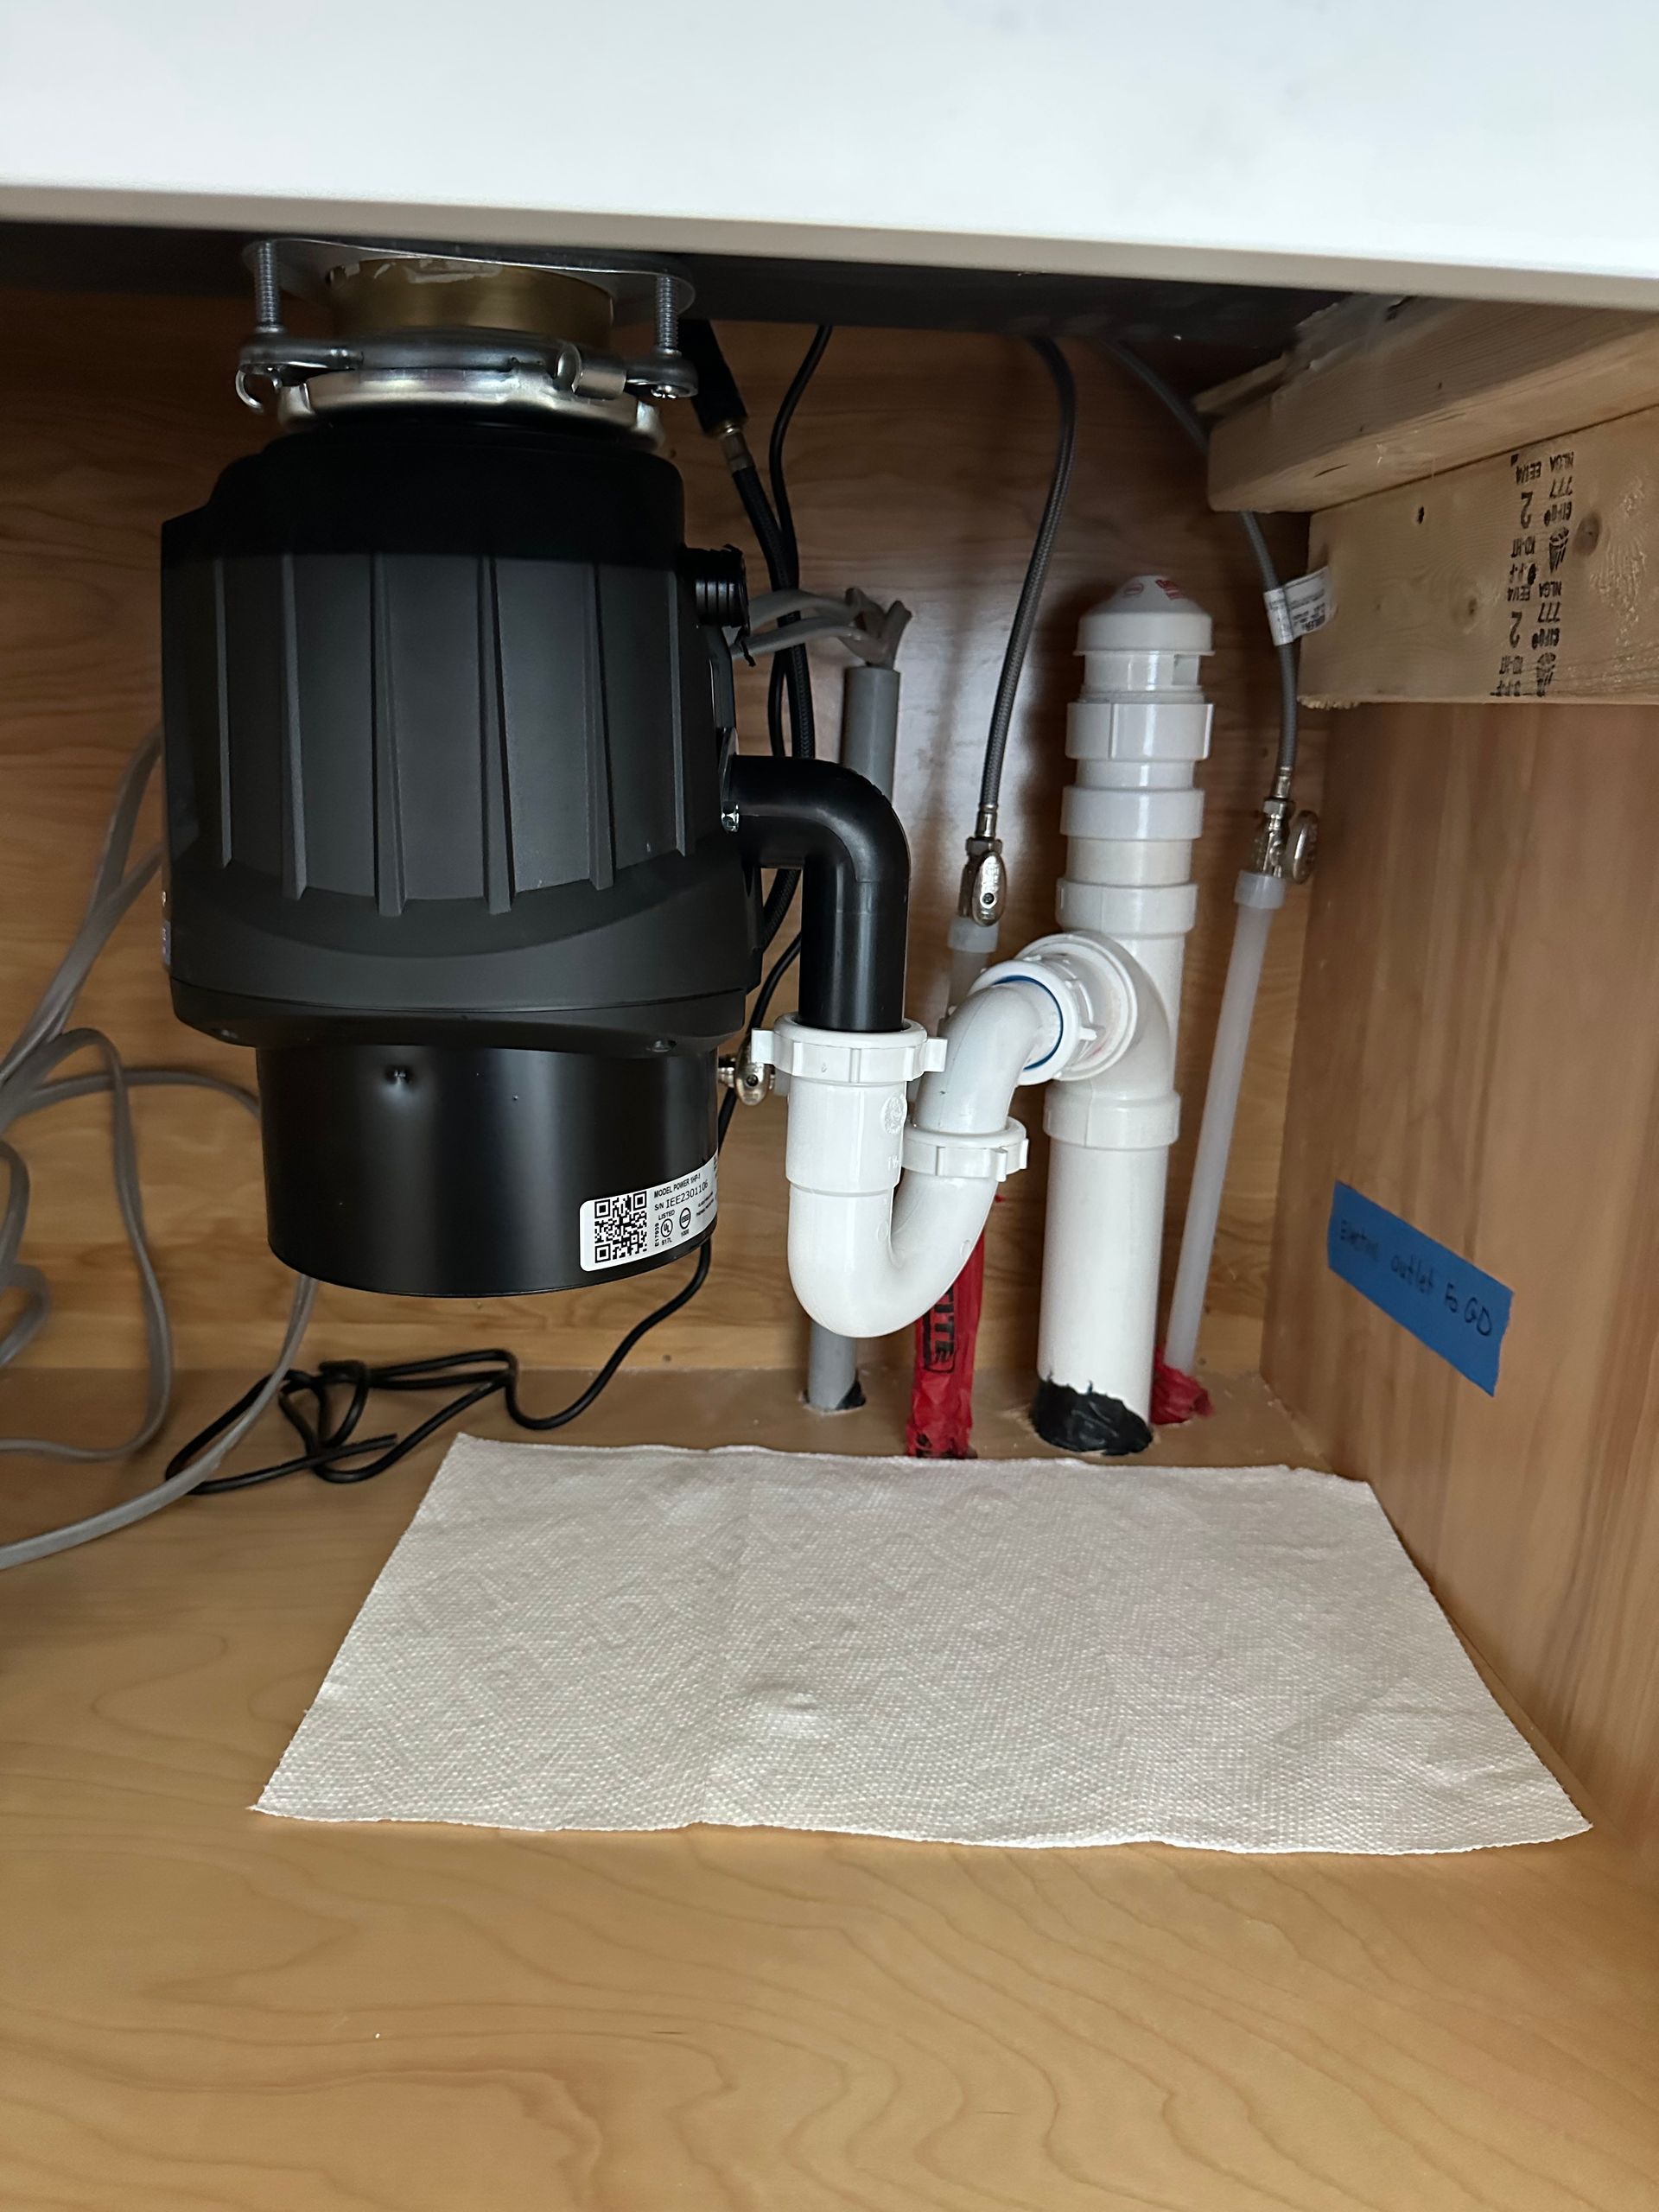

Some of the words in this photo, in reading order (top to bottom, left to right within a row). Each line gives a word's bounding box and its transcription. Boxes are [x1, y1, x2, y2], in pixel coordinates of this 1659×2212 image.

[1549, 476, 1573, 499] 777
[1521, 491, 1534, 531] 2
[1538, 581, 1562, 599] NLGA
[1537, 602, 1561, 624] 777
[1509, 611, 1522, 649] 2
[653, 1186, 673, 1198] MODEL
[673, 1178, 690, 1192] POWER
[654, 1202, 664, 1211] S/N
[665, 1179, 709, 1209] IEE2301106
[658, 1210, 676, 1221] LISTED
